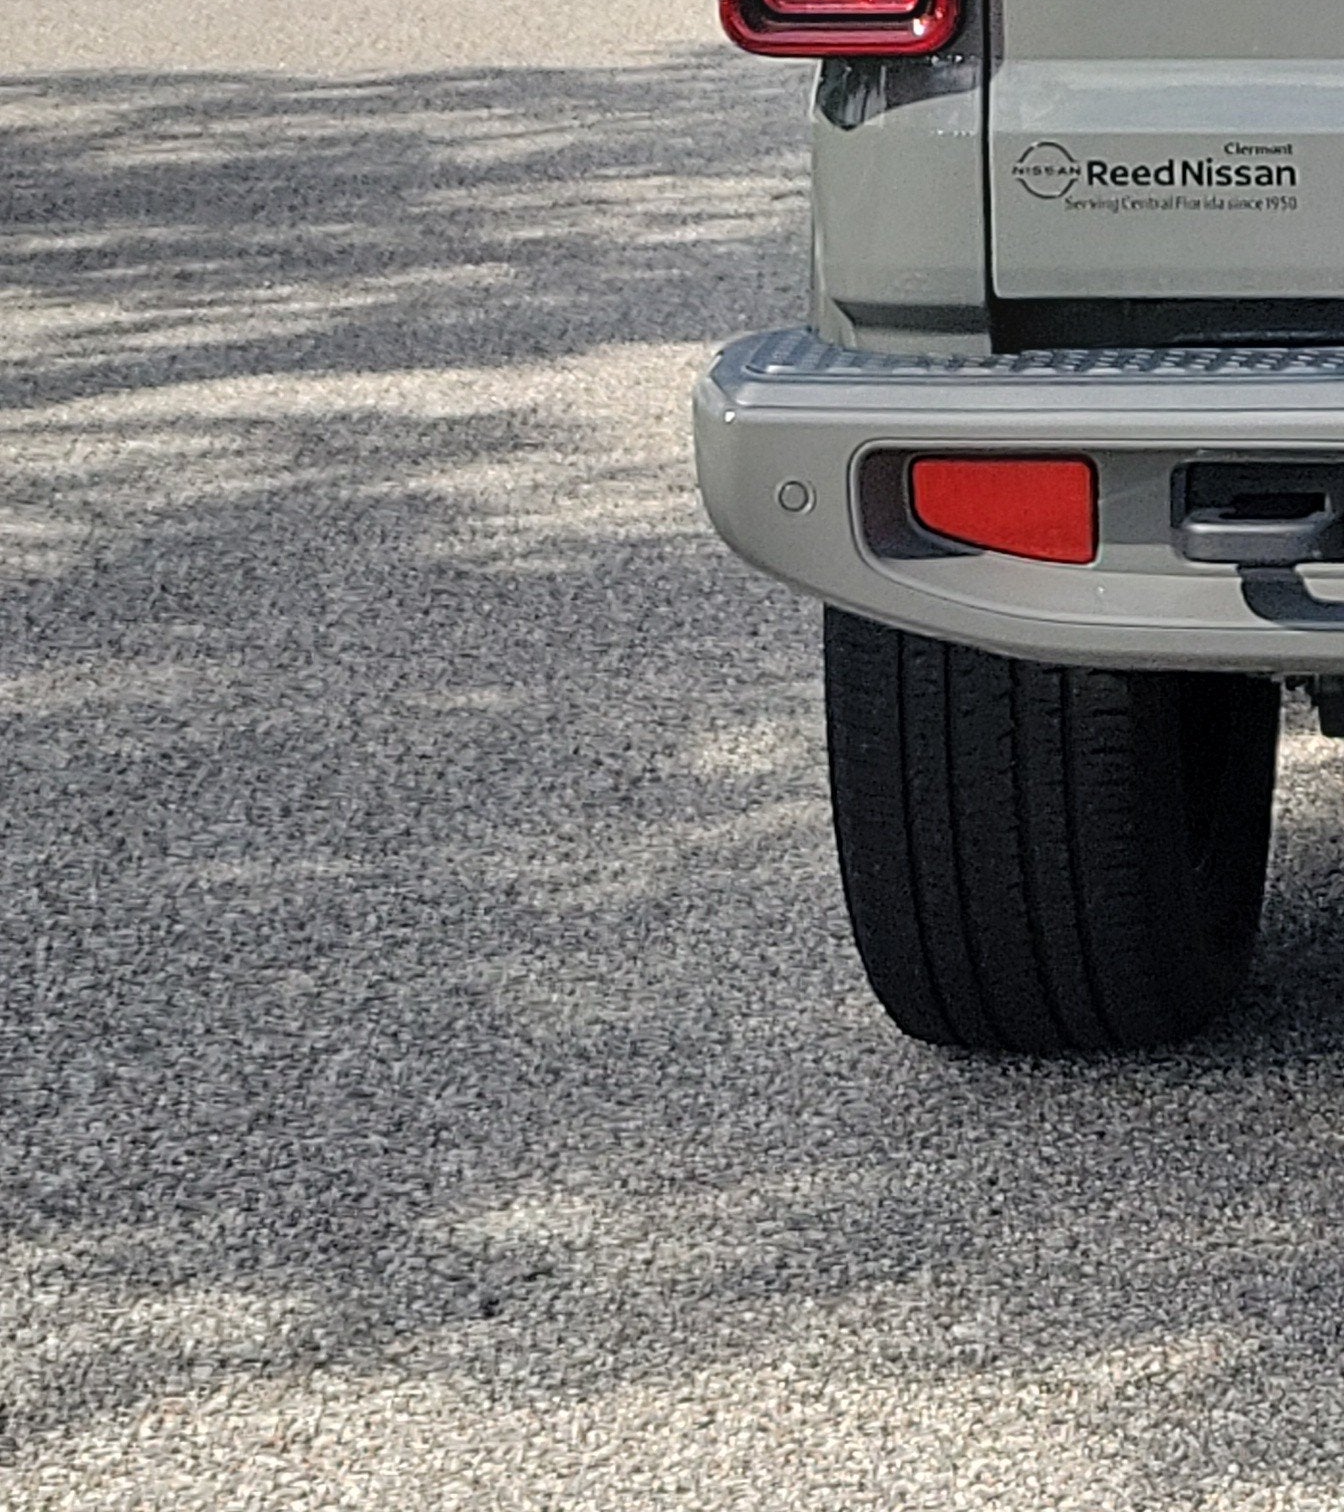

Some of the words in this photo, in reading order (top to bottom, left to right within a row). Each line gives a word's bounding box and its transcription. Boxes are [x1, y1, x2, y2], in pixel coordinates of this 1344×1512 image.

[1225, 142, 1293, 155] Clermont
[1012, 166, 1081, 176] NISSAN
[1087, 159, 1174, 186] Reed
[1182, 157, 1297, 186] Nissan
[1065, 195, 1119, 212] Serving
[1122, 195, 1173, 210] Central
[1177, 195, 1224, 210] Florida
[1228, 196, 1261, 210] since
[1266, 196, 1297, 210] 1950
